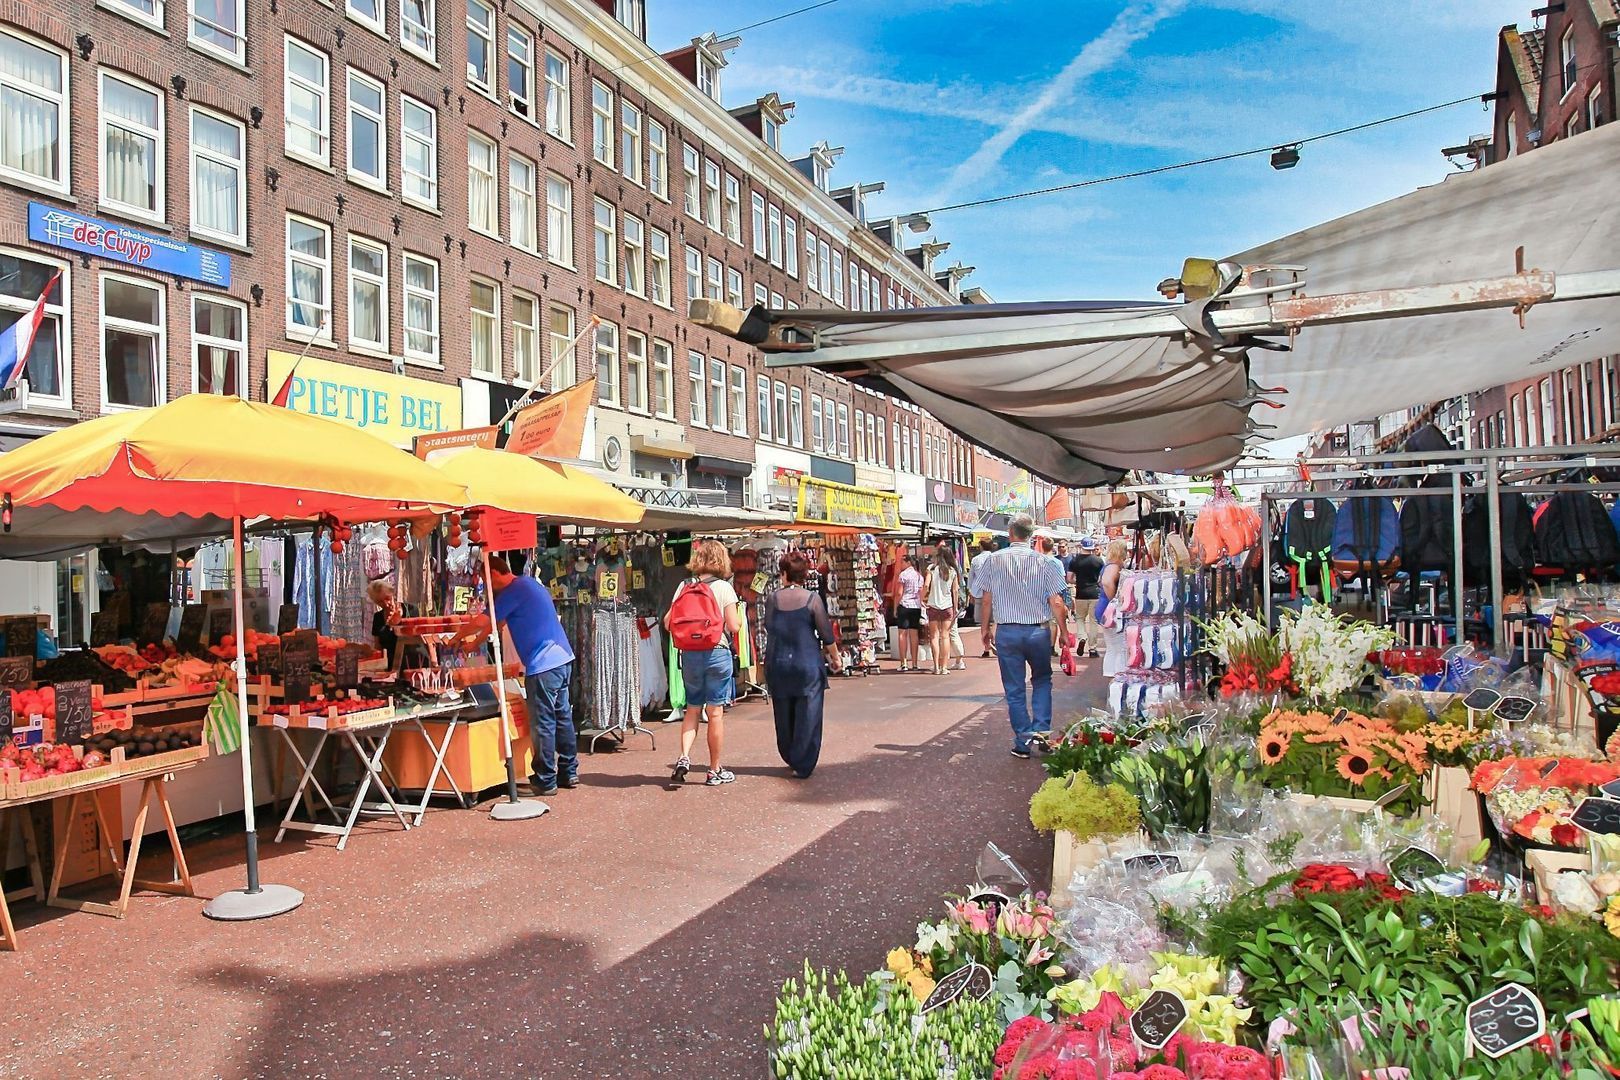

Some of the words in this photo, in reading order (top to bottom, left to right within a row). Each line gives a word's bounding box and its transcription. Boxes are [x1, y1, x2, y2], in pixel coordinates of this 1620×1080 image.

[73, 222, 98, 246] de
[103, 229, 152, 265] Cuyp
[286, 376, 389, 427] PIETJE
[400, 395, 449, 432] BEL
[832, 488, 878, 510] SOUVENIRS
[1489, 989, 1537, 1028] 350
